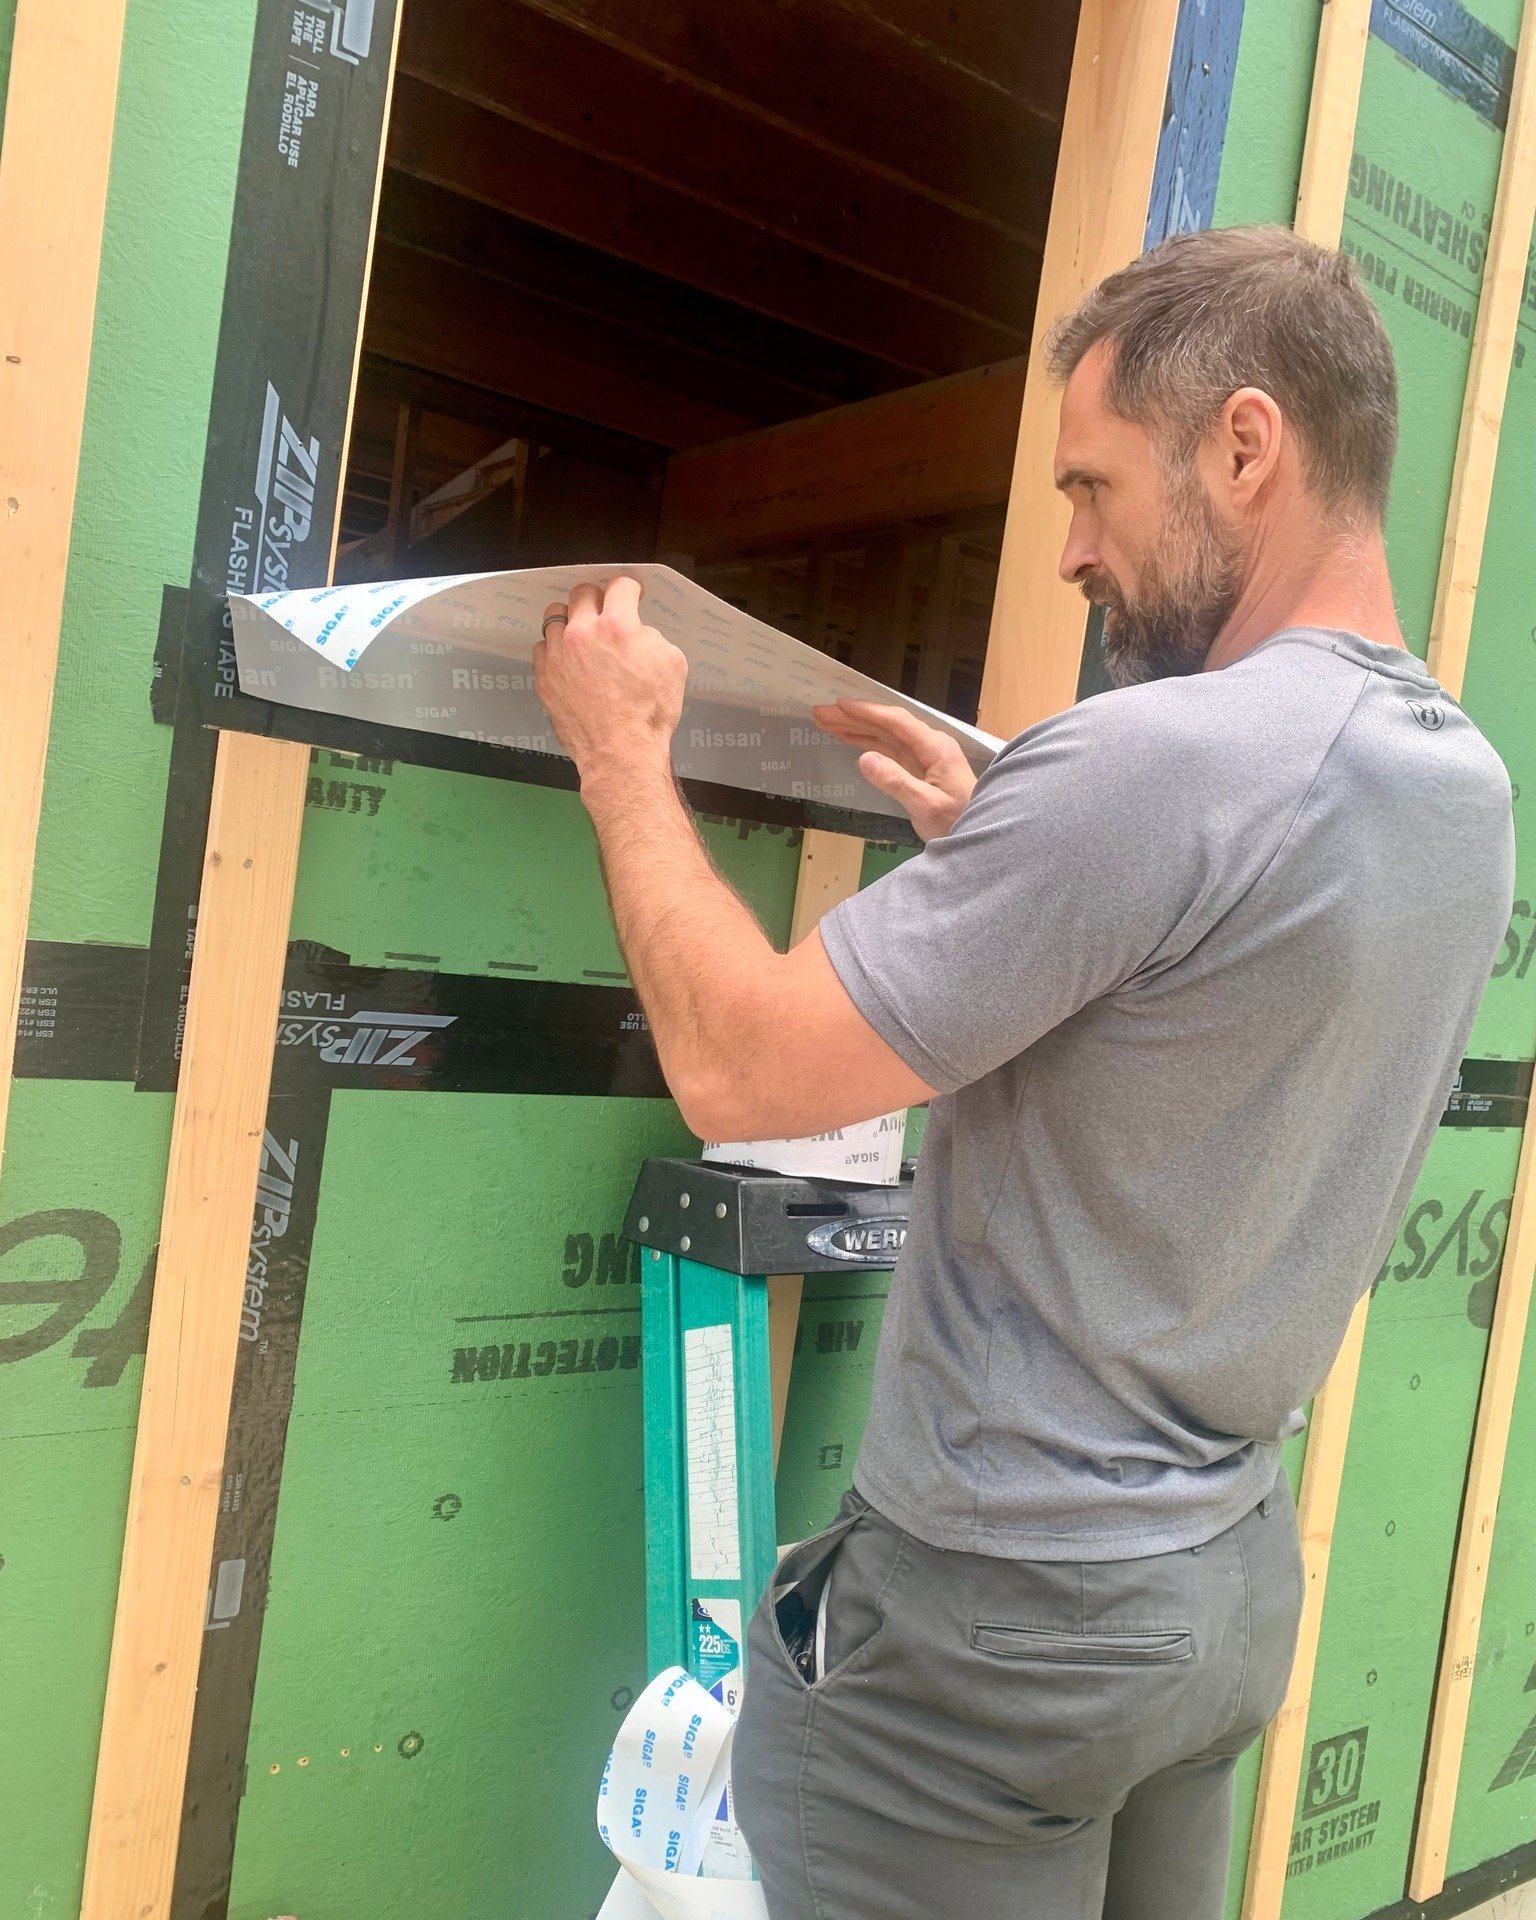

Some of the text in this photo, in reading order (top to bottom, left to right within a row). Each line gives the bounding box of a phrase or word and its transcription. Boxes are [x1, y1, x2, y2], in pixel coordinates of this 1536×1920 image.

[291, 10, 304, 46] TAPE
[302, 14, 316, 43] THE
[312, 18, 326, 54] ROLL
[277, 70, 297, 154] EL RODILLO
[305, 80, 319, 118] PARA
[287, 75, 308, 168] APLICAR USE
[273, 414, 320, 543] ZIP
[262, 591, 293, 611] IGA
[370, 597, 403, 628] SIGA
[315, 608, 347, 646] SIGA
[410, 643, 446, 656] SIGA
[214, 640, 237, 699] TAPE
[317, 666, 414, 690] Rissan
[415, 707, 448, 718] SIGA
[759, 706, 785, 717] SIGA
[690, 728, 762, 748] Rissan
[760, 761, 786, 771] SIGA
[791, 781, 856, 798] Rissan
[20, 997, 57, 1006] ESR #33
[40, 987, 57, 995] ULC
[36, 1019, 55, 1027] ESR
[37, 1008, 56, 1017] ESR
[35, 1029, 54, 1038] ESR
[319, 1028, 433, 1066] ZIP
[851, 1151, 880, 1164] SIGA
[699, 1634, 721, 1654] 225
[641, 1729, 656, 1764] SIGA
[683, 1714, 702, 1755] SIGA
[1312, 1738, 1360, 1806] 30
[675, 1774, 690, 1805] SIGA
[631, 1788, 647, 1830] SIGA
[1318, 1800, 1381, 1846] SYSTEM
[664, 1830, 680, 1871] SIGA
[1316, 1829, 1376, 1868] WARRANTY
